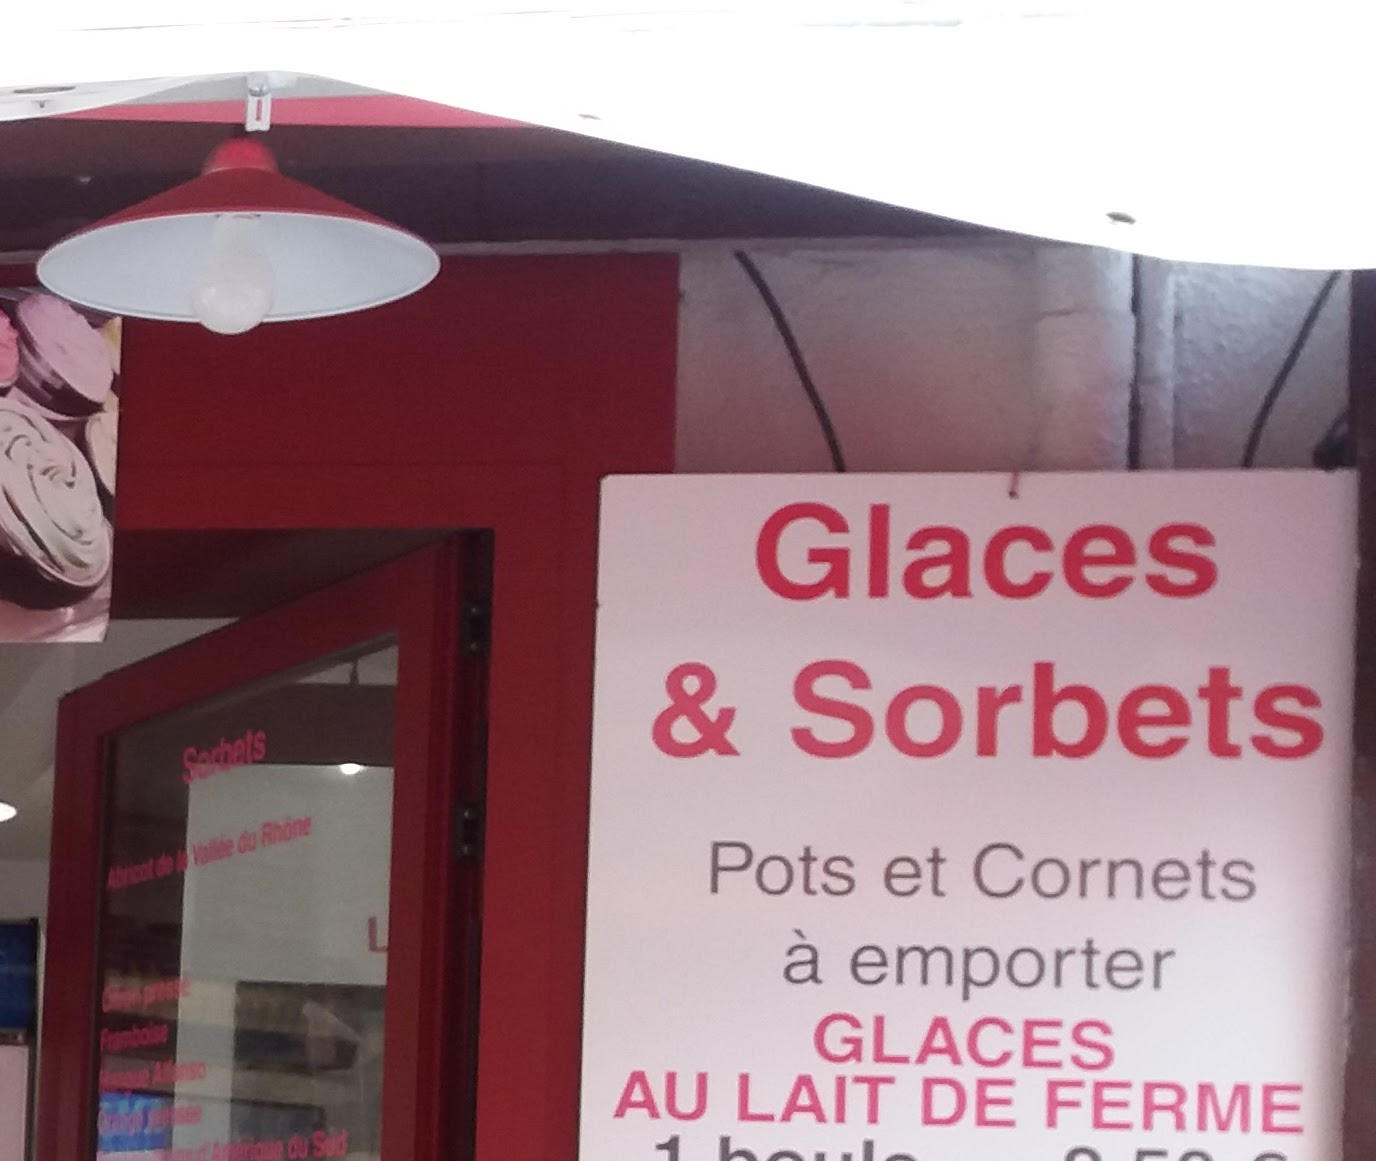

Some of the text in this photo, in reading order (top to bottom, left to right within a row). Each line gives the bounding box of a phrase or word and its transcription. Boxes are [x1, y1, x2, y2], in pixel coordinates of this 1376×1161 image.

[755, 500, 1219, 602] Glaces
[651, 658, 1325, 761] & Sorbets
[182, 730, 267, 785] Sorbets
[708, 840, 1258, 902] Pots et Cornets
[782, 929, 1177, 1001] à emporter
[813, 1011, 1116, 1071] GLACES
[613, 1070, 1305, 1134] AU LAIT DE FERME
